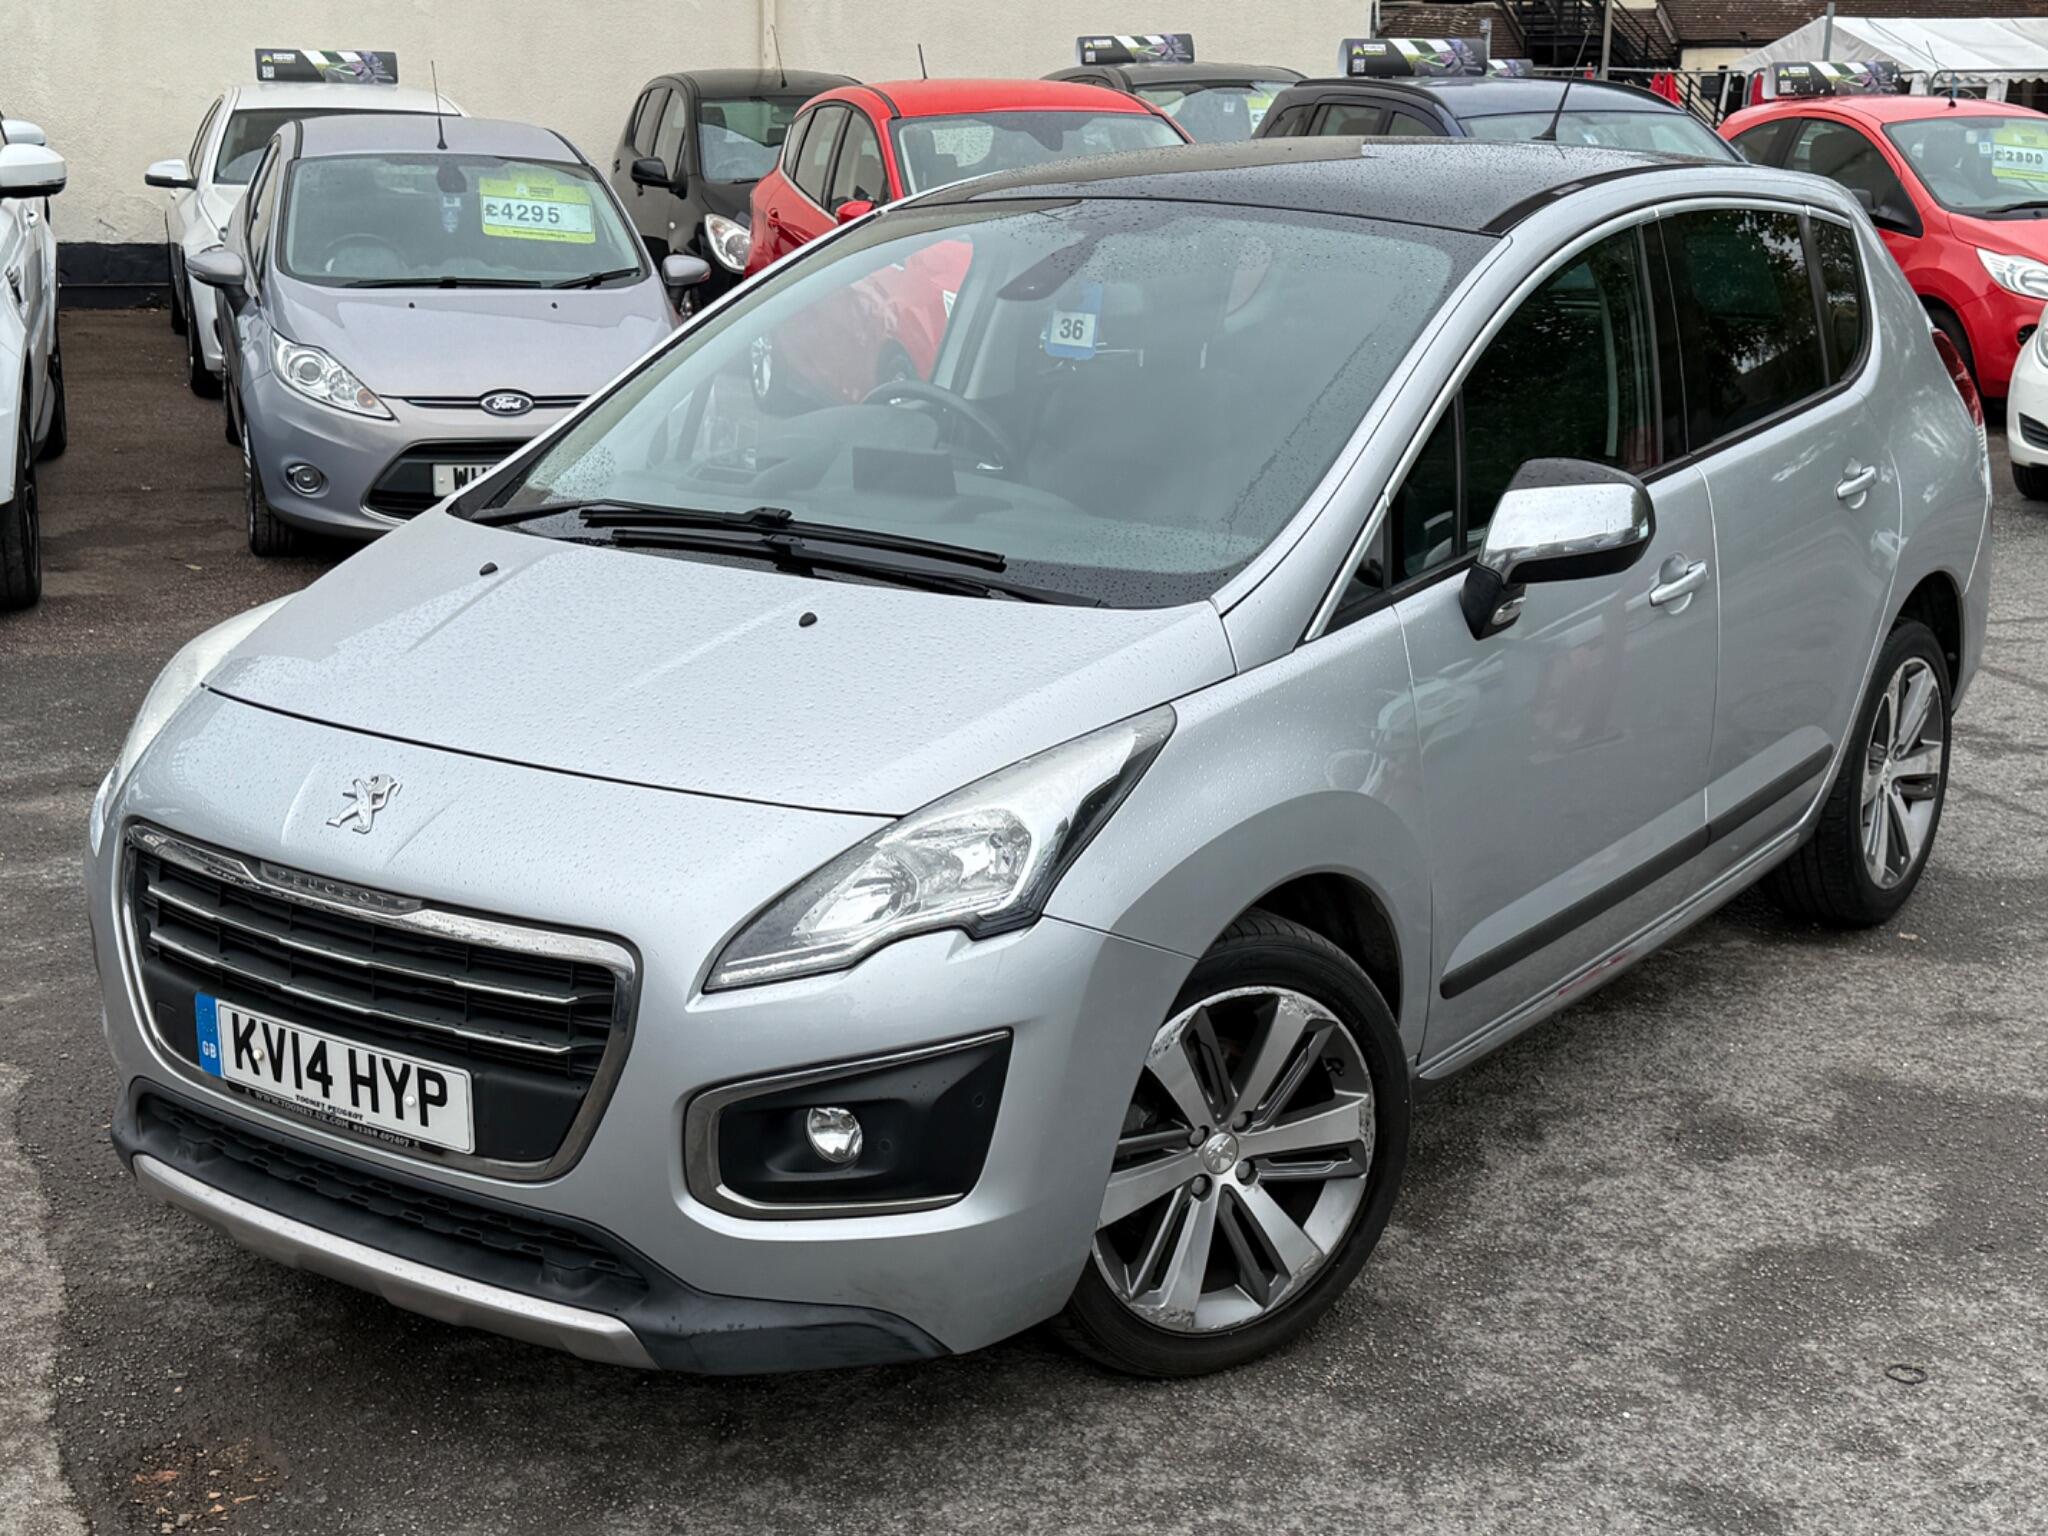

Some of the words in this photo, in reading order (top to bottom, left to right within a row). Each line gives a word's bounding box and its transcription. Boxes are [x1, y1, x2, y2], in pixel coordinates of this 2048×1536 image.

[484, 203, 560, 224] £4295
[1059, 318, 1084, 340] 36
[492, 396, 521, 410] Ford
[277, 871, 387, 907] PEUGEOT
[202, 1040, 217, 1059] GB
[231, 1012, 333, 1099] KV14
[348, 1047, 448, 1127] HYP
